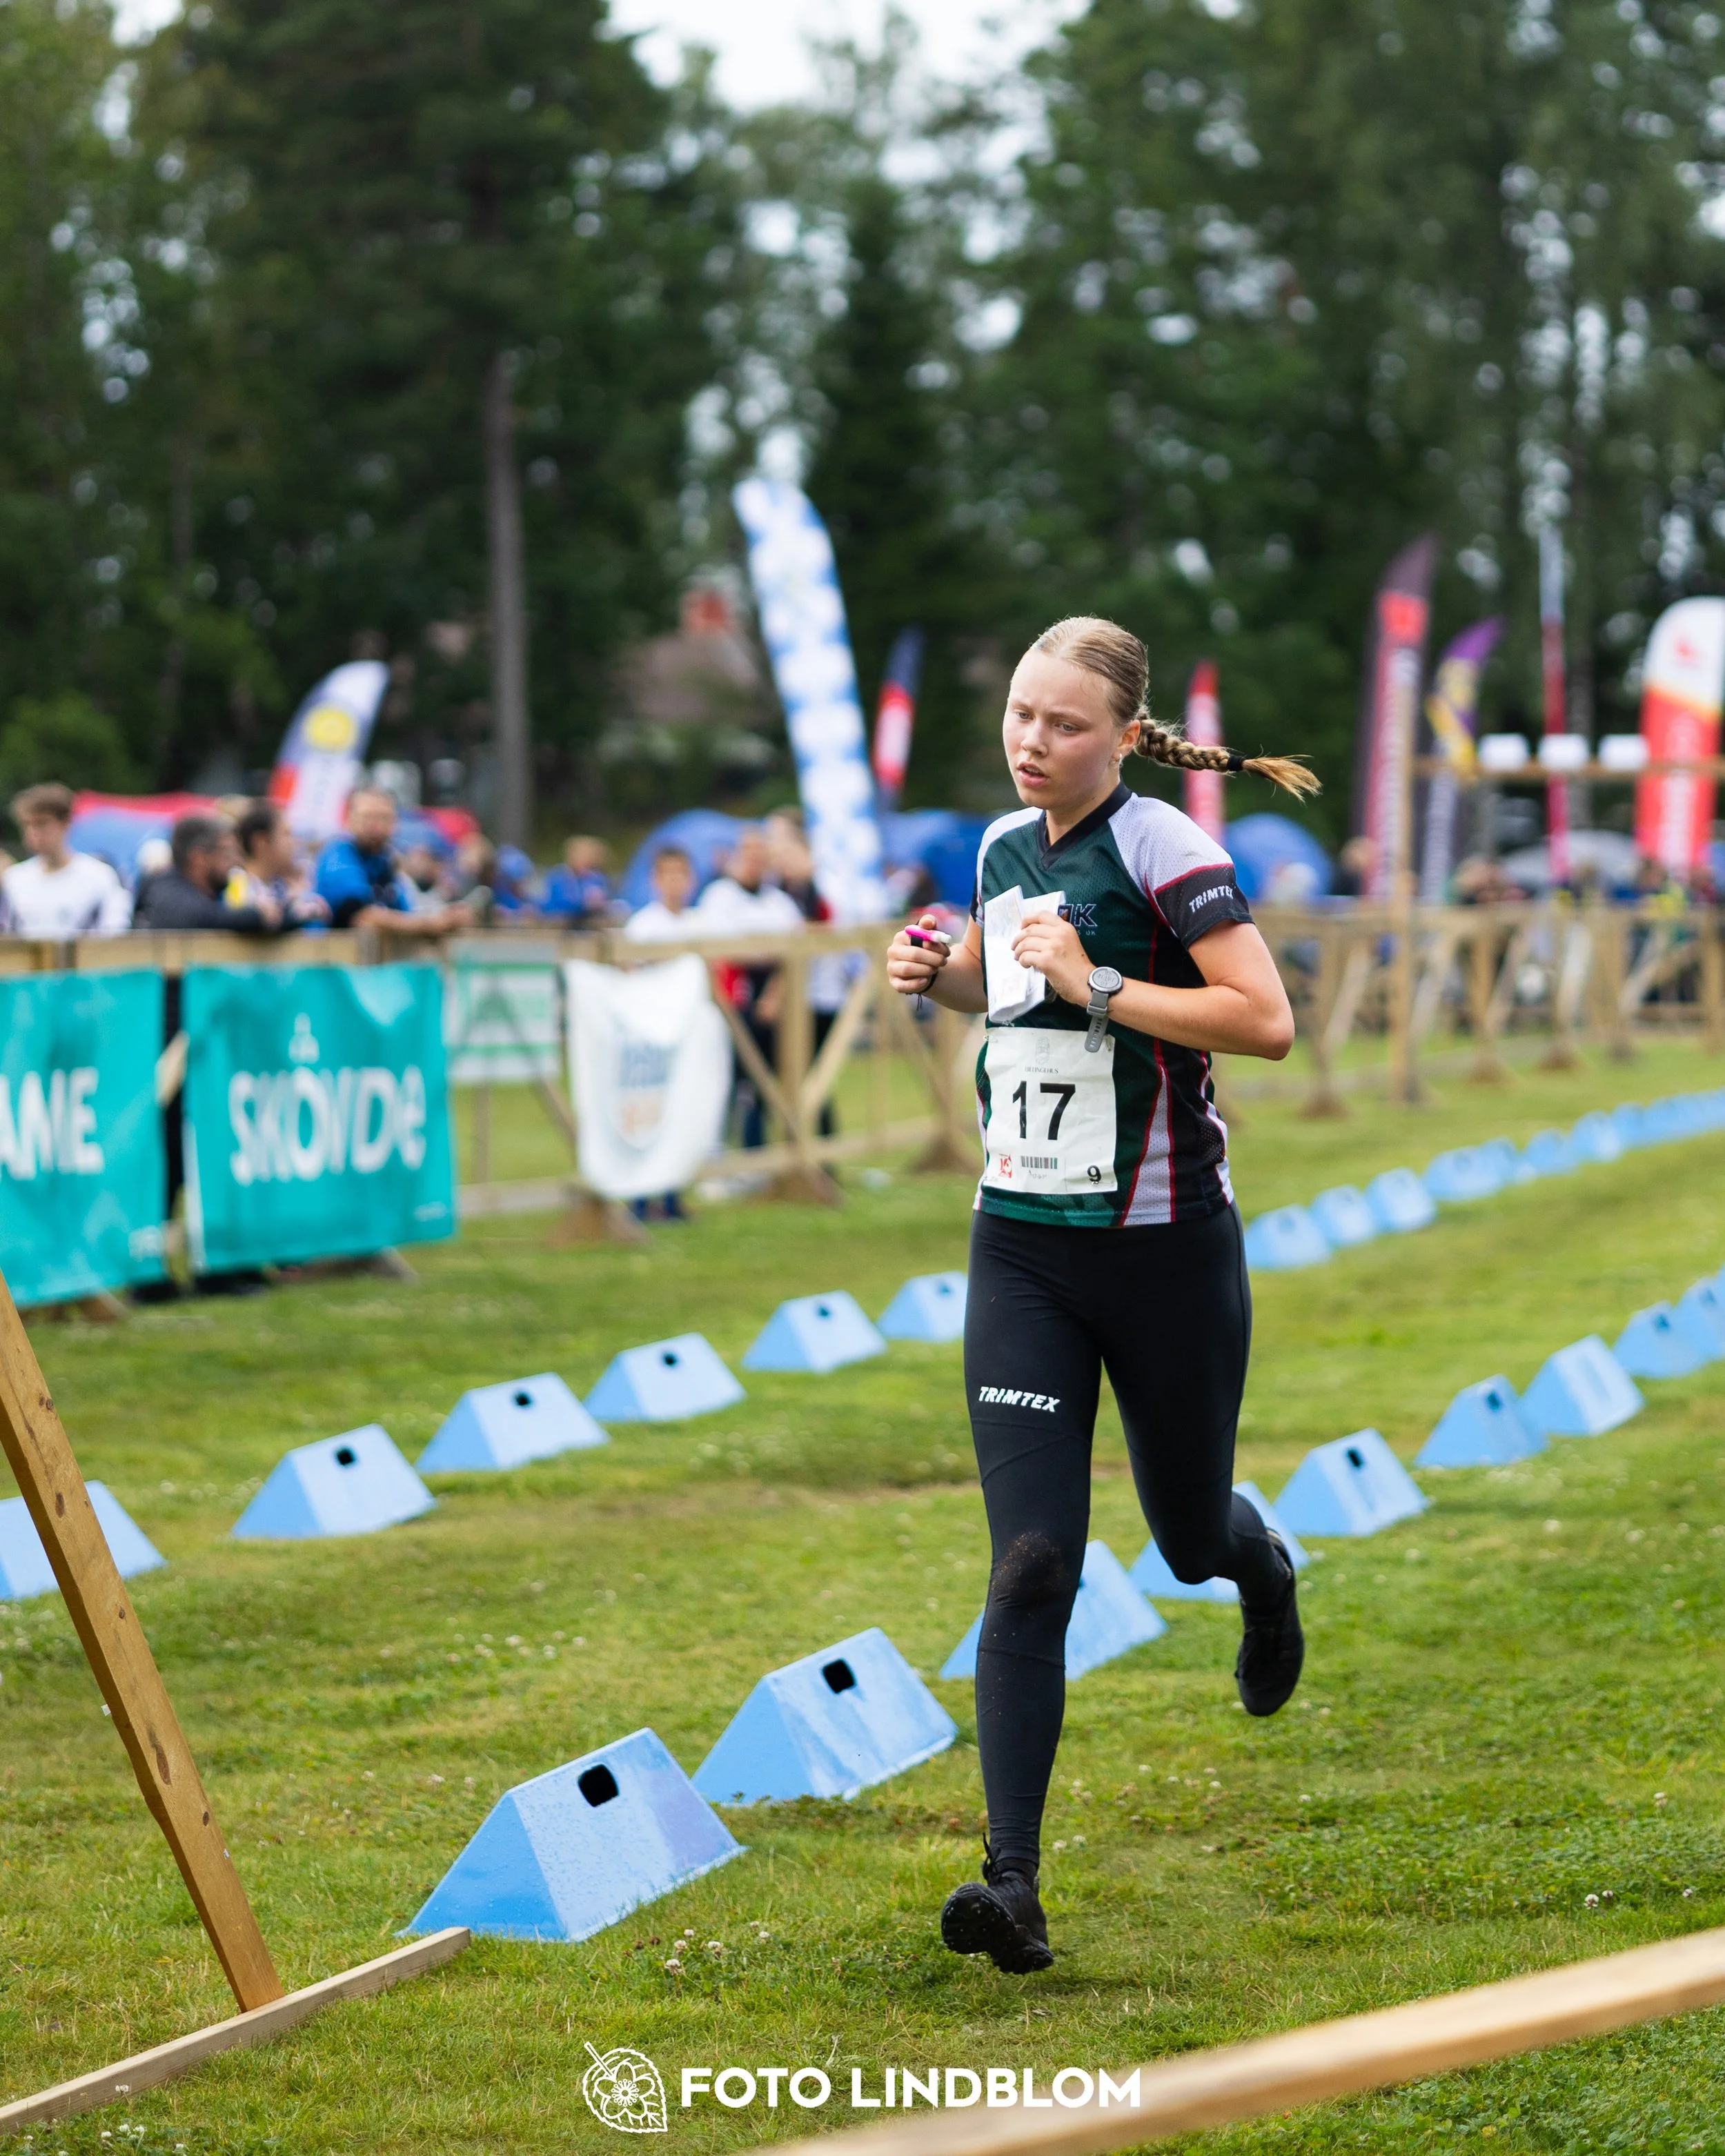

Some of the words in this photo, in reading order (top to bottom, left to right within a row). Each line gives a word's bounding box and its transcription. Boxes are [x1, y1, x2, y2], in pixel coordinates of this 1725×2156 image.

[1189, 885, 1233, 913] TRIMTEX
[1012, 1080, 1076, 1140] 17
[1087, 1165, 1101, 1182] 9
[978, 1386, 1061, 1413] TRIMTEX
